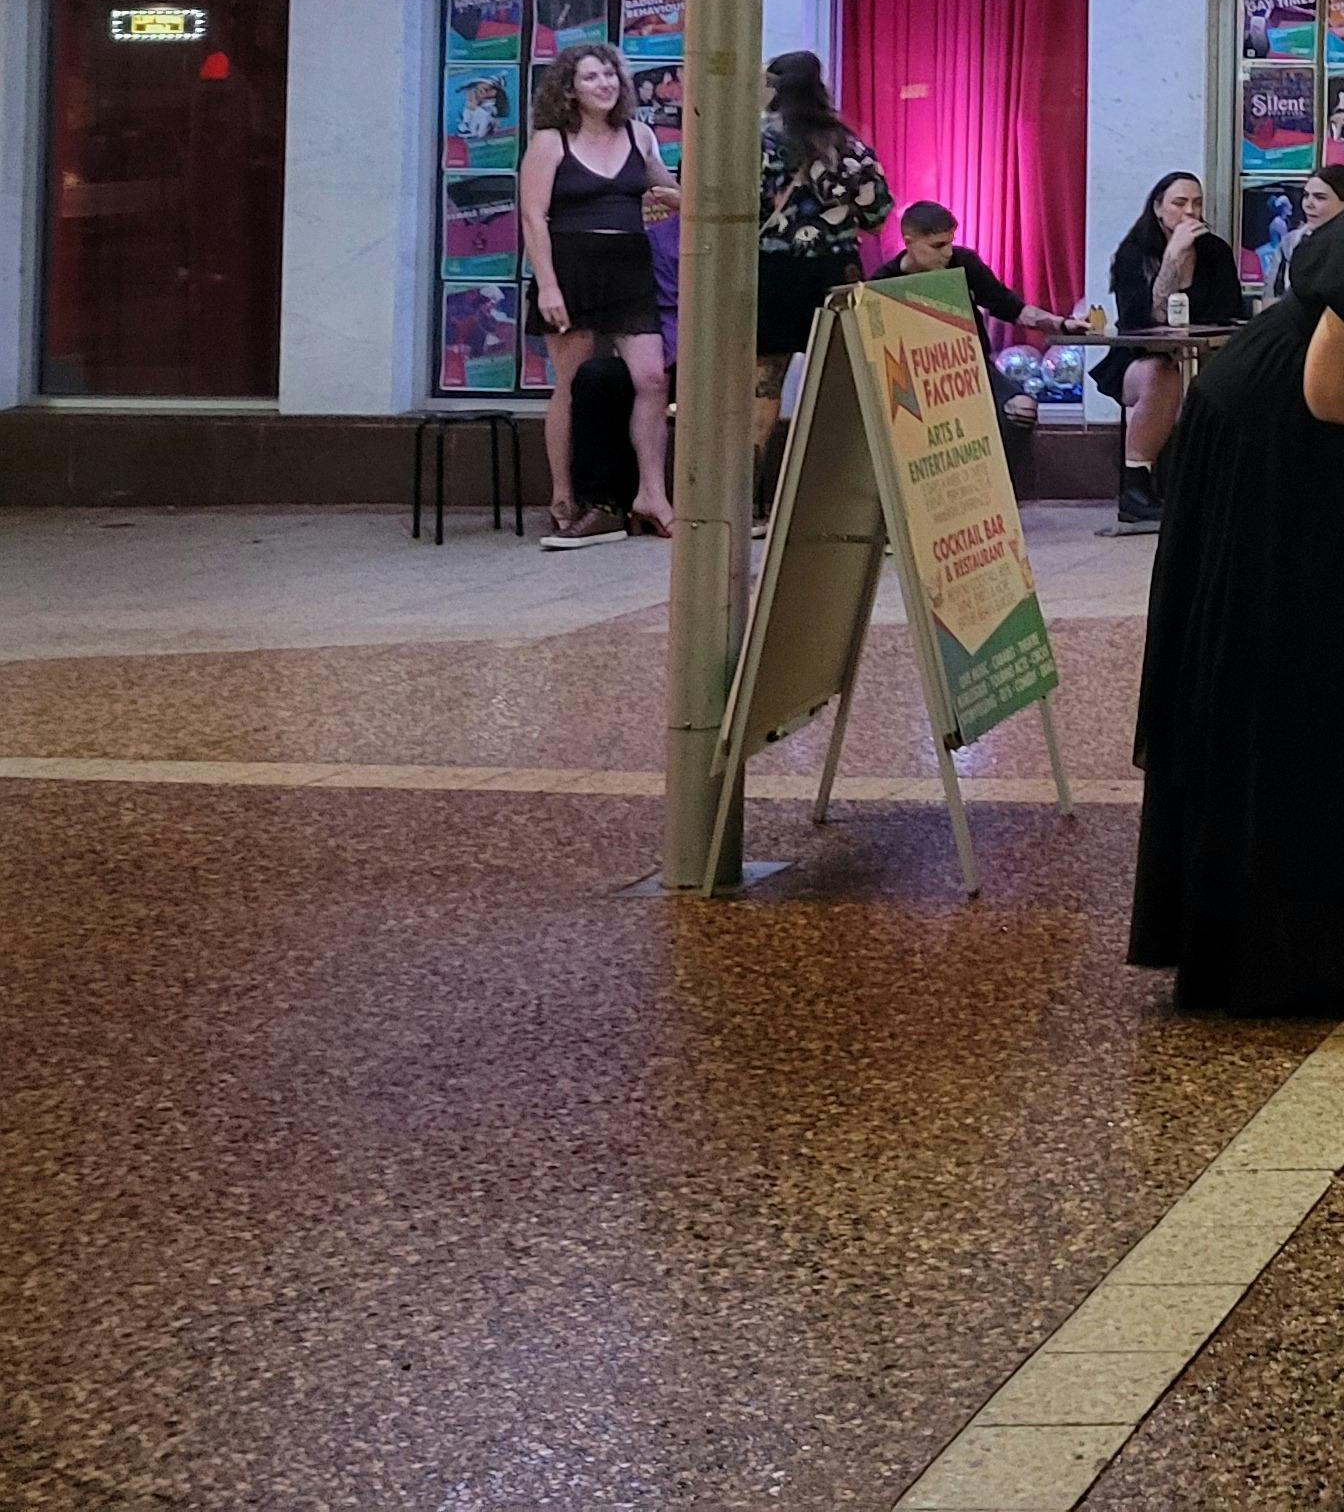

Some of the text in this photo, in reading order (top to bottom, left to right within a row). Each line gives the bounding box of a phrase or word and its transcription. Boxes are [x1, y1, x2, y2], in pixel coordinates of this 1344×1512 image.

[1252, 93, 1306, 116] Silent
[911, 336, 977, 377] FUNHAUS
[923, 366, 982, 408] FACTORY
[928, 420, 953, 447] ARTS
[908, 435, 992, 484] ENTERTAINMENT
[933, 513, 1006, 563] COCKTAIL BAR
[953, 541, 1005, 579] RESTAURANT
